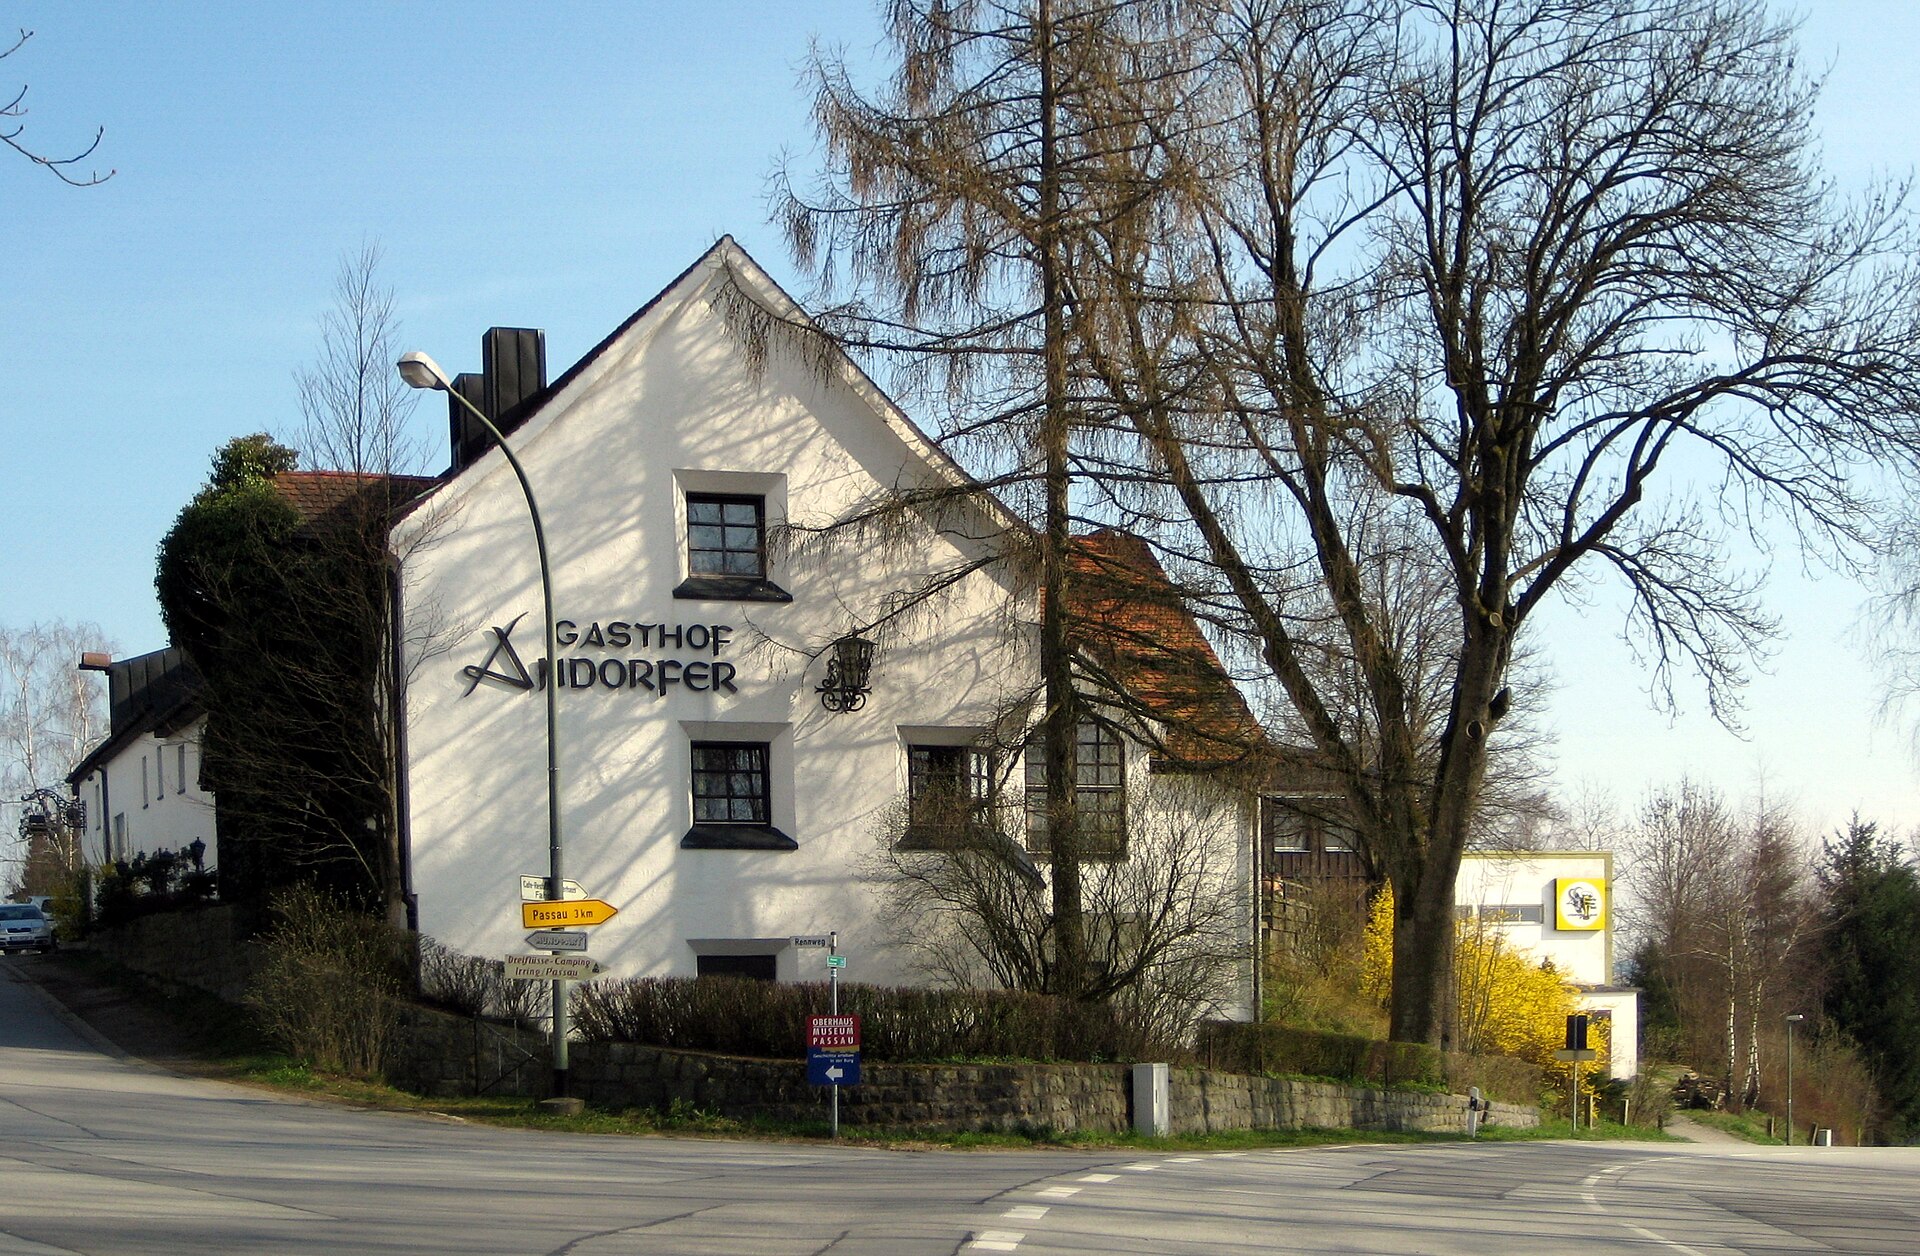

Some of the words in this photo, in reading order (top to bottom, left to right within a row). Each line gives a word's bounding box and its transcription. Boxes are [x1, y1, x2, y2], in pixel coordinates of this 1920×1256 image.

[556, 620, 733, 656] GASTHOF
[532, 909, 568, 921] Passau
[574, 909, 579, 919] 3
[580, 909, 593, 918] km
[794, 938, 826, 947] Rennweg
[508, 955, 591, 969] Dreiflüsse-Camping
[812, 1017, 854, 1026] OBERHAUS
[812, 1027, 854, 1036] MUSEUM
[812, 1036, 854, 1045] PASSAU
